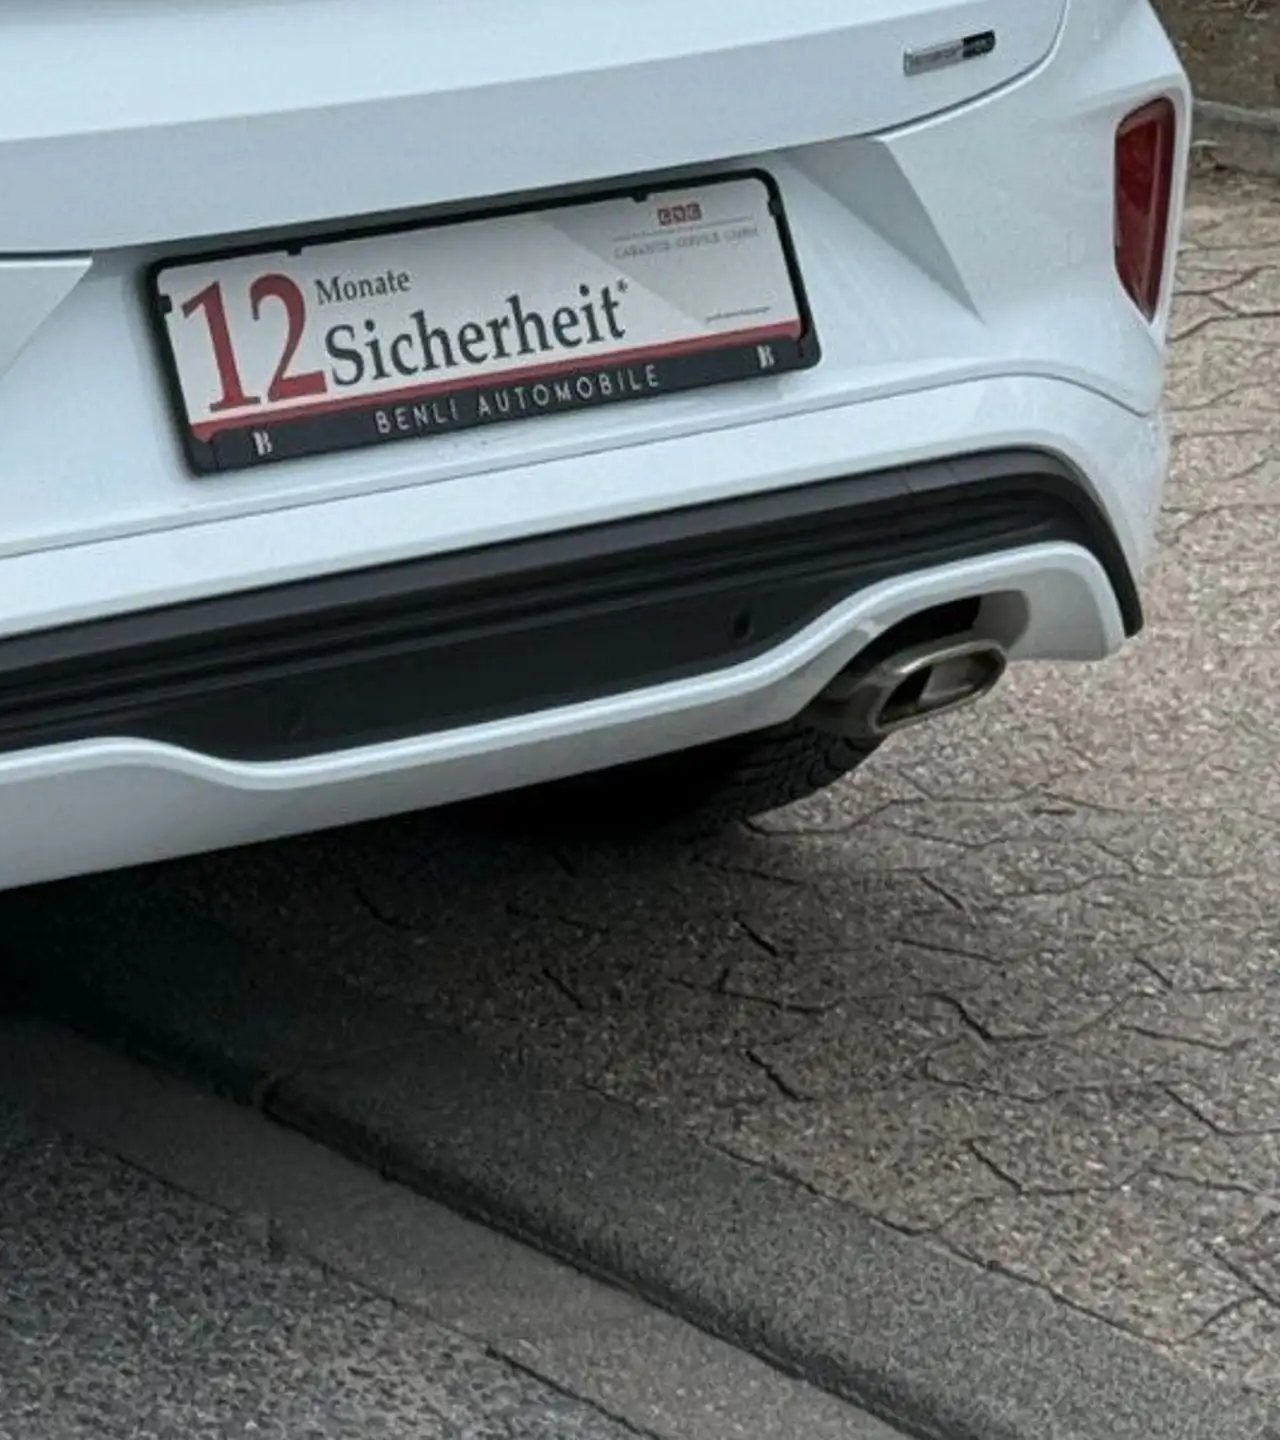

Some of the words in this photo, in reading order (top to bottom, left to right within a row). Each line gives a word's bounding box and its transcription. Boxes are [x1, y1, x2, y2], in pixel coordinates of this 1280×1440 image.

[314, 268, 412, 306] Monate
[181, 273, 328, 413] 12
[374, 405, 460, 435] BENLI
[476, 364, 663, 419] AUTOMOBILE
